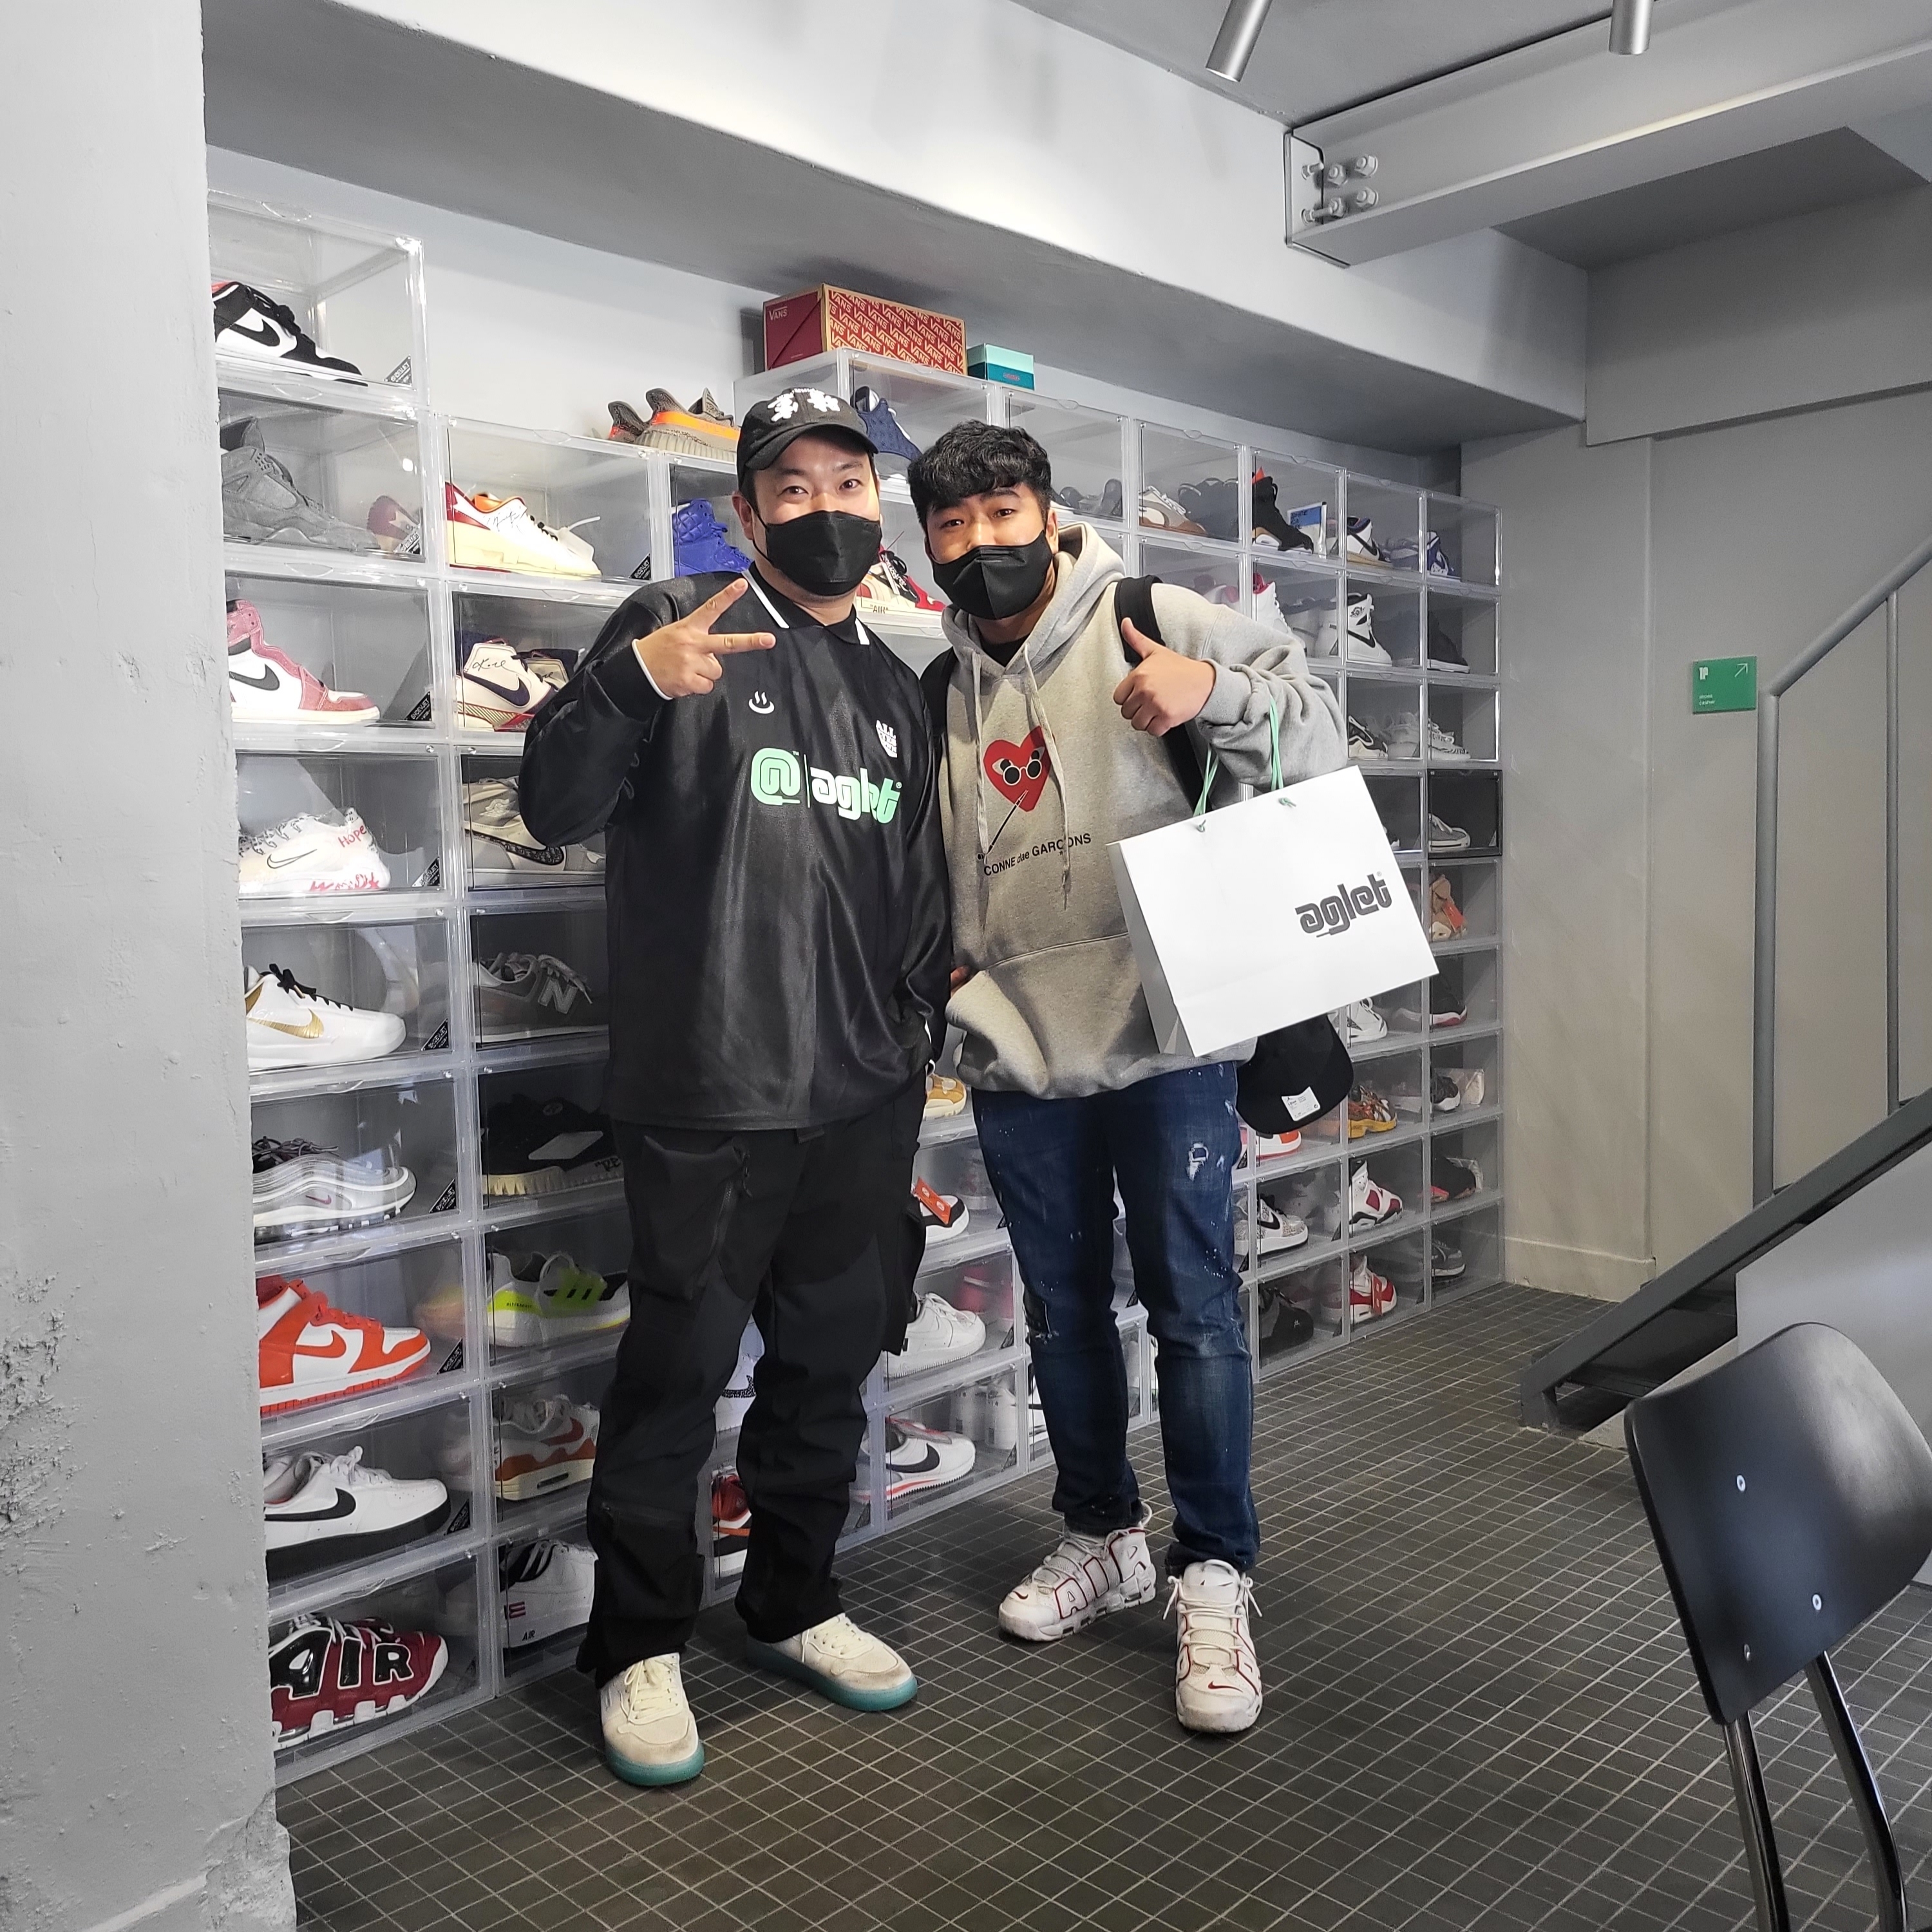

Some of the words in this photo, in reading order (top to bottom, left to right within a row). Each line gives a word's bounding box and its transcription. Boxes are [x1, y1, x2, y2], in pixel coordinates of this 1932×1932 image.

[831, 290, 853, 312] VANS
[769, 307, 788, 320] VANS
[840, 308, 860, 333] VANS
[854, 307, 875, 331] VANS
[868, 305, 889, 329] VANS
[882, 303, 903, 327] VANS
[862, 327, 882, 352] VANS
[876, 326, 896, 350] VANS
[890, 323, 910, 348] VANS
[904, 322, 923, 346] VANS
[917, 320, 936, 343] VANS
[931, 319, 949, 341] VANS
[925, 340, 943, 363] VANS
[938, 338, 956, 361] VANS
[338, 825, 366, 848] Hope
[984, 857, 1016, 876] CONNE
[1017, 851, 1030, 864] dae
[522, 1630, 535, 1641] AIR
[270, 1626, 414, 1701] AIR
